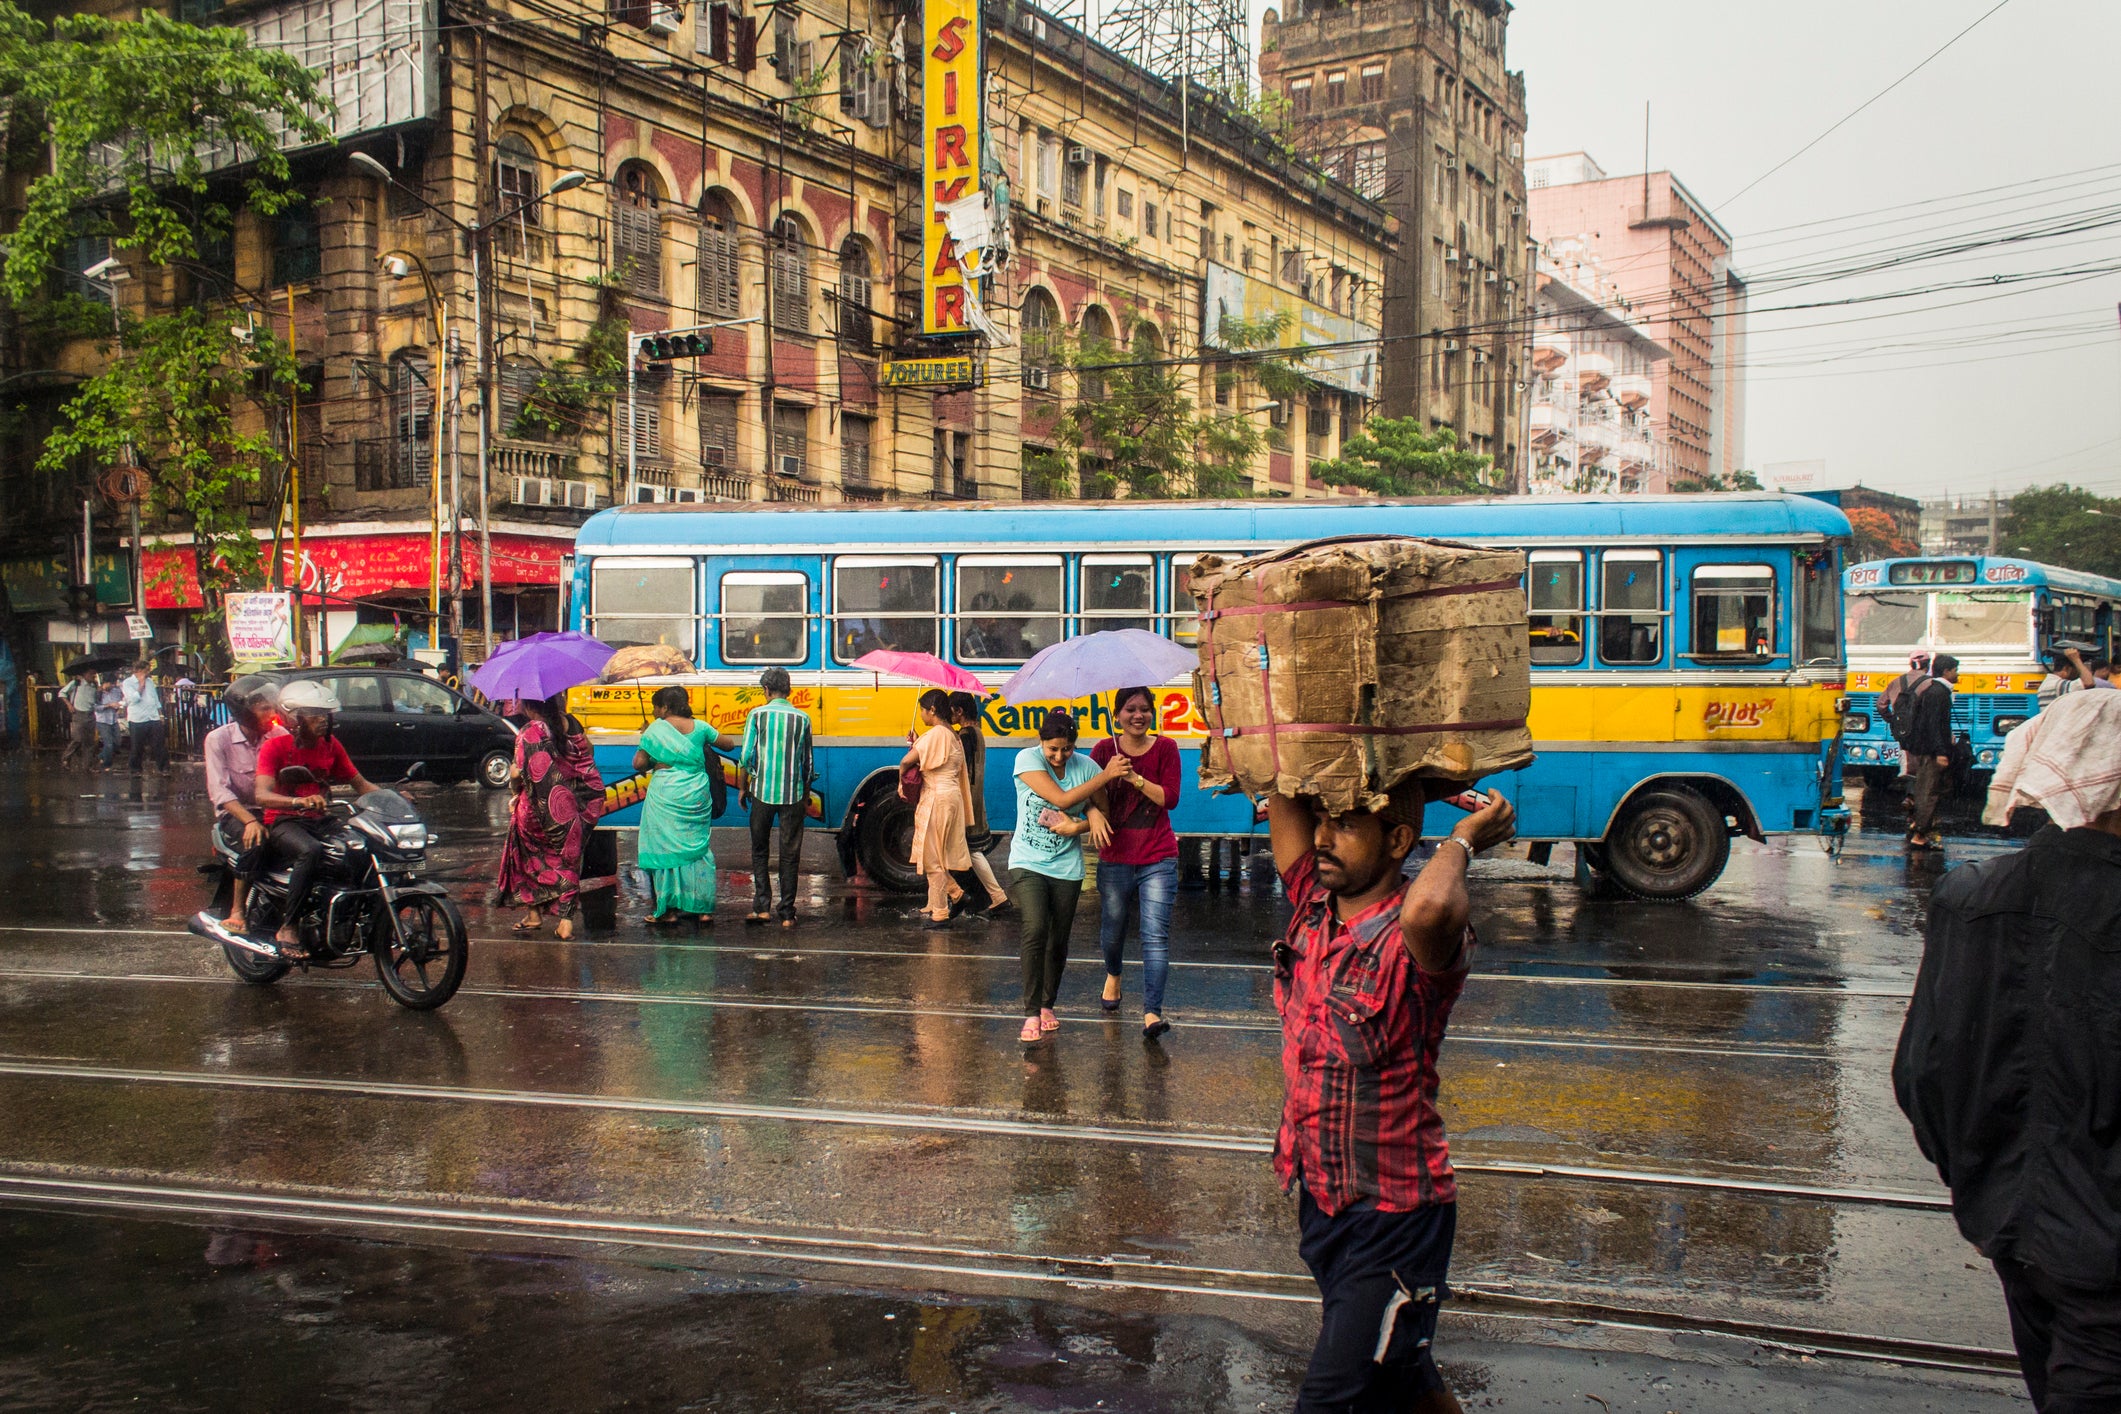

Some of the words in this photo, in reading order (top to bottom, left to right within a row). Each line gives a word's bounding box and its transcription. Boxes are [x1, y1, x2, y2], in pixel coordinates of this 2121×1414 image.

[932, 16, 971, 328] SIRKAR
[883, 361, 968, 384] JOHUREE
[1911, 567, 1958, 581] 47B
[1704, 700, 1766, 729] Pilot
